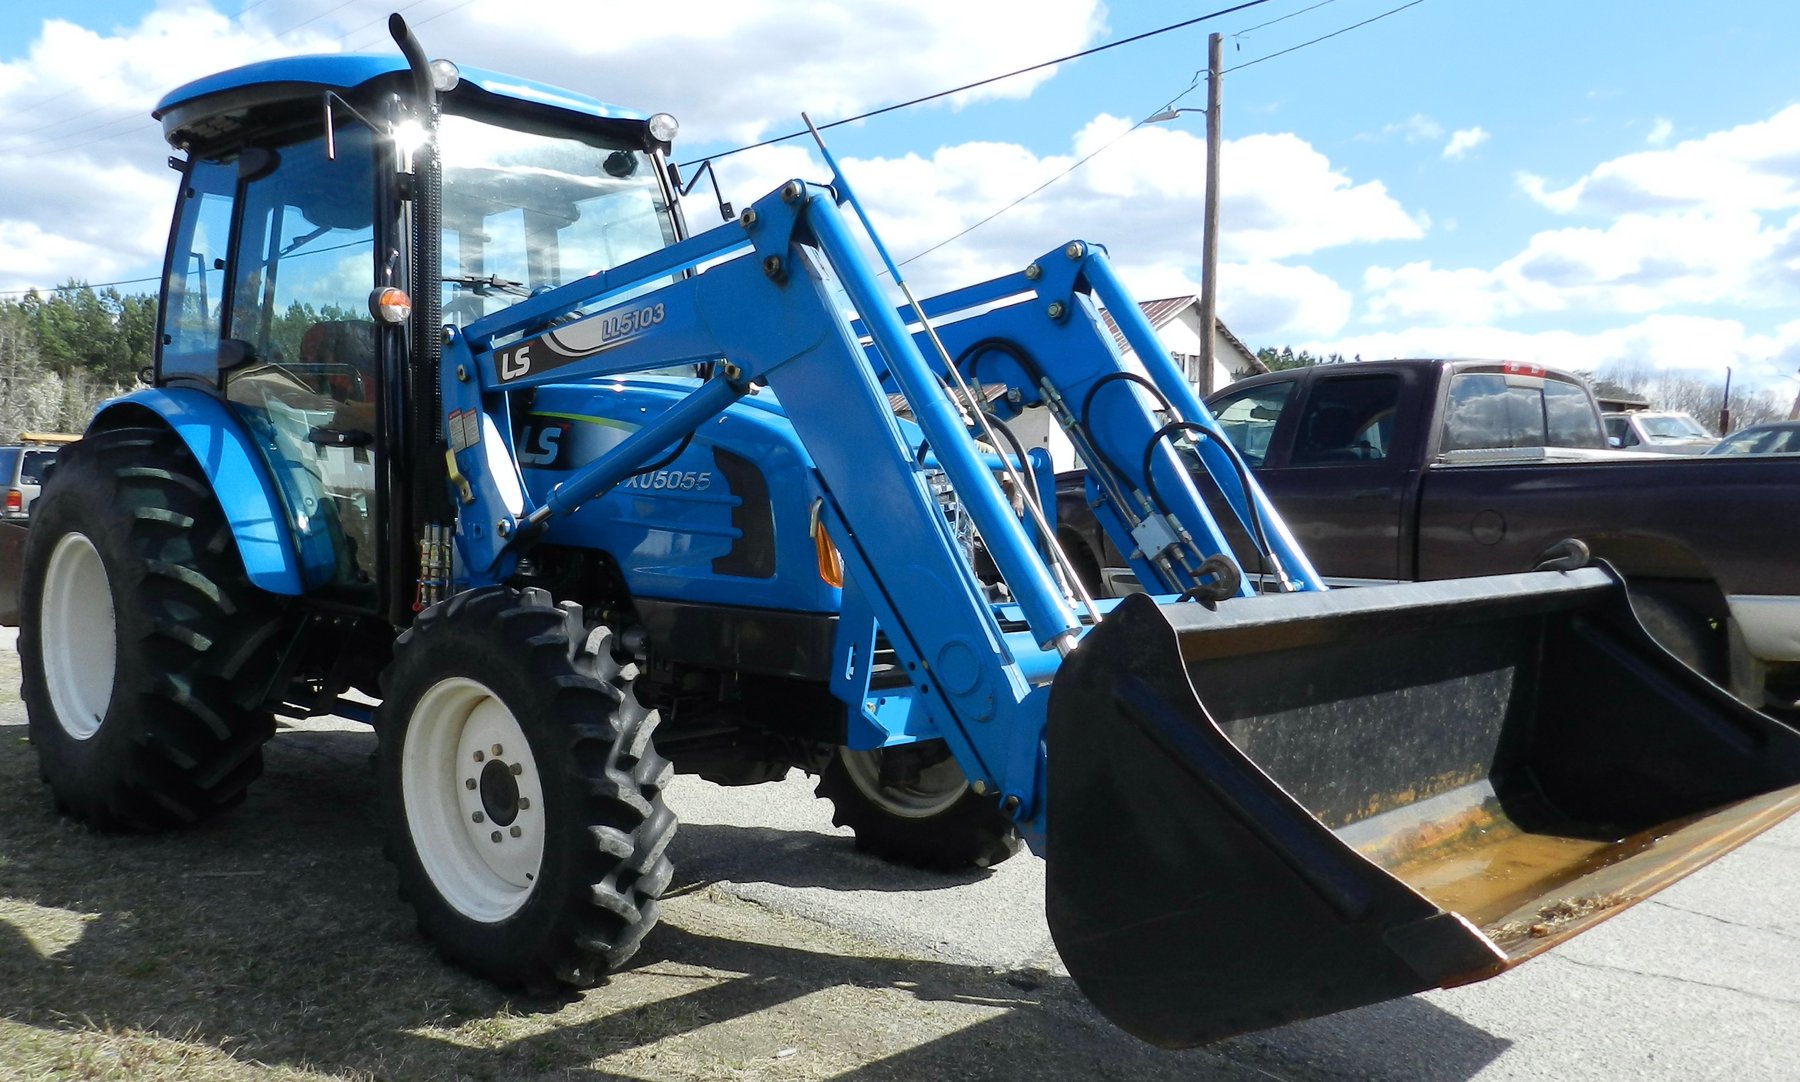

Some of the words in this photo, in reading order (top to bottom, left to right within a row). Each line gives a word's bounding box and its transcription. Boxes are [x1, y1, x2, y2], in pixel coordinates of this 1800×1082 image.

[501, 346, 531, 380] LS
[602, 303, 665, 342] LL5103
[517, 425, 562, 465] LS
